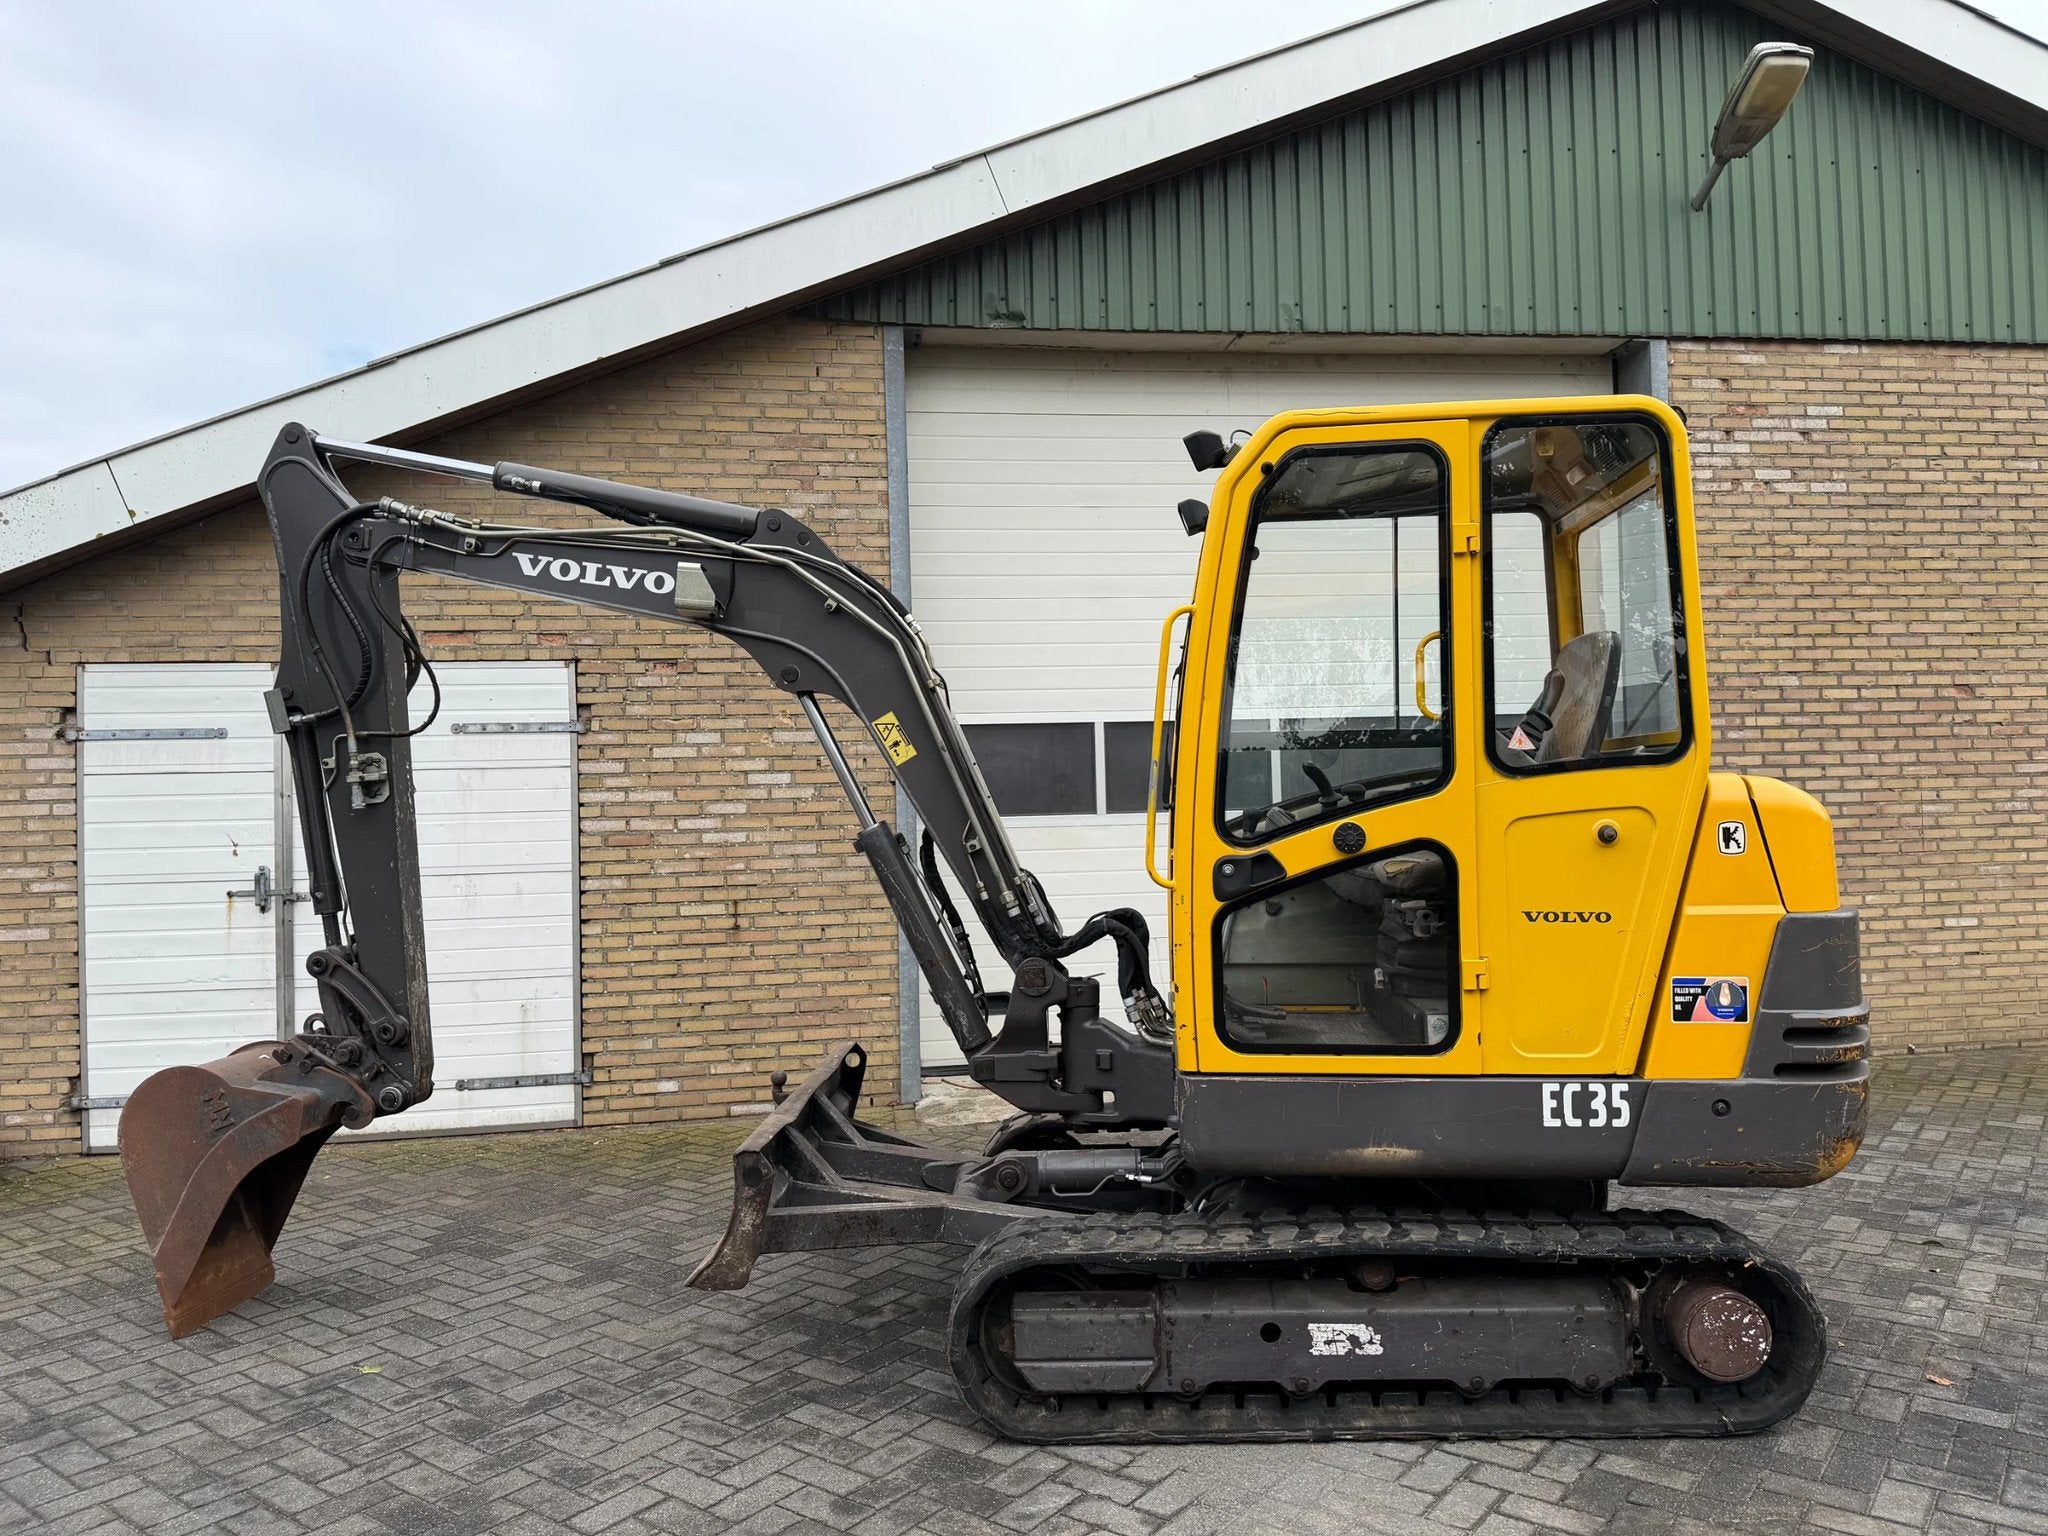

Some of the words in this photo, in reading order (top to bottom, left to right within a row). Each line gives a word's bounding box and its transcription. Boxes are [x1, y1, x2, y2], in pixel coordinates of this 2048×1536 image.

[512, 552, 675, 594] VOLVO
[1521, 910, 1612, 923] VOLVO
[1542, 1083, 1630, 1127] EC35
